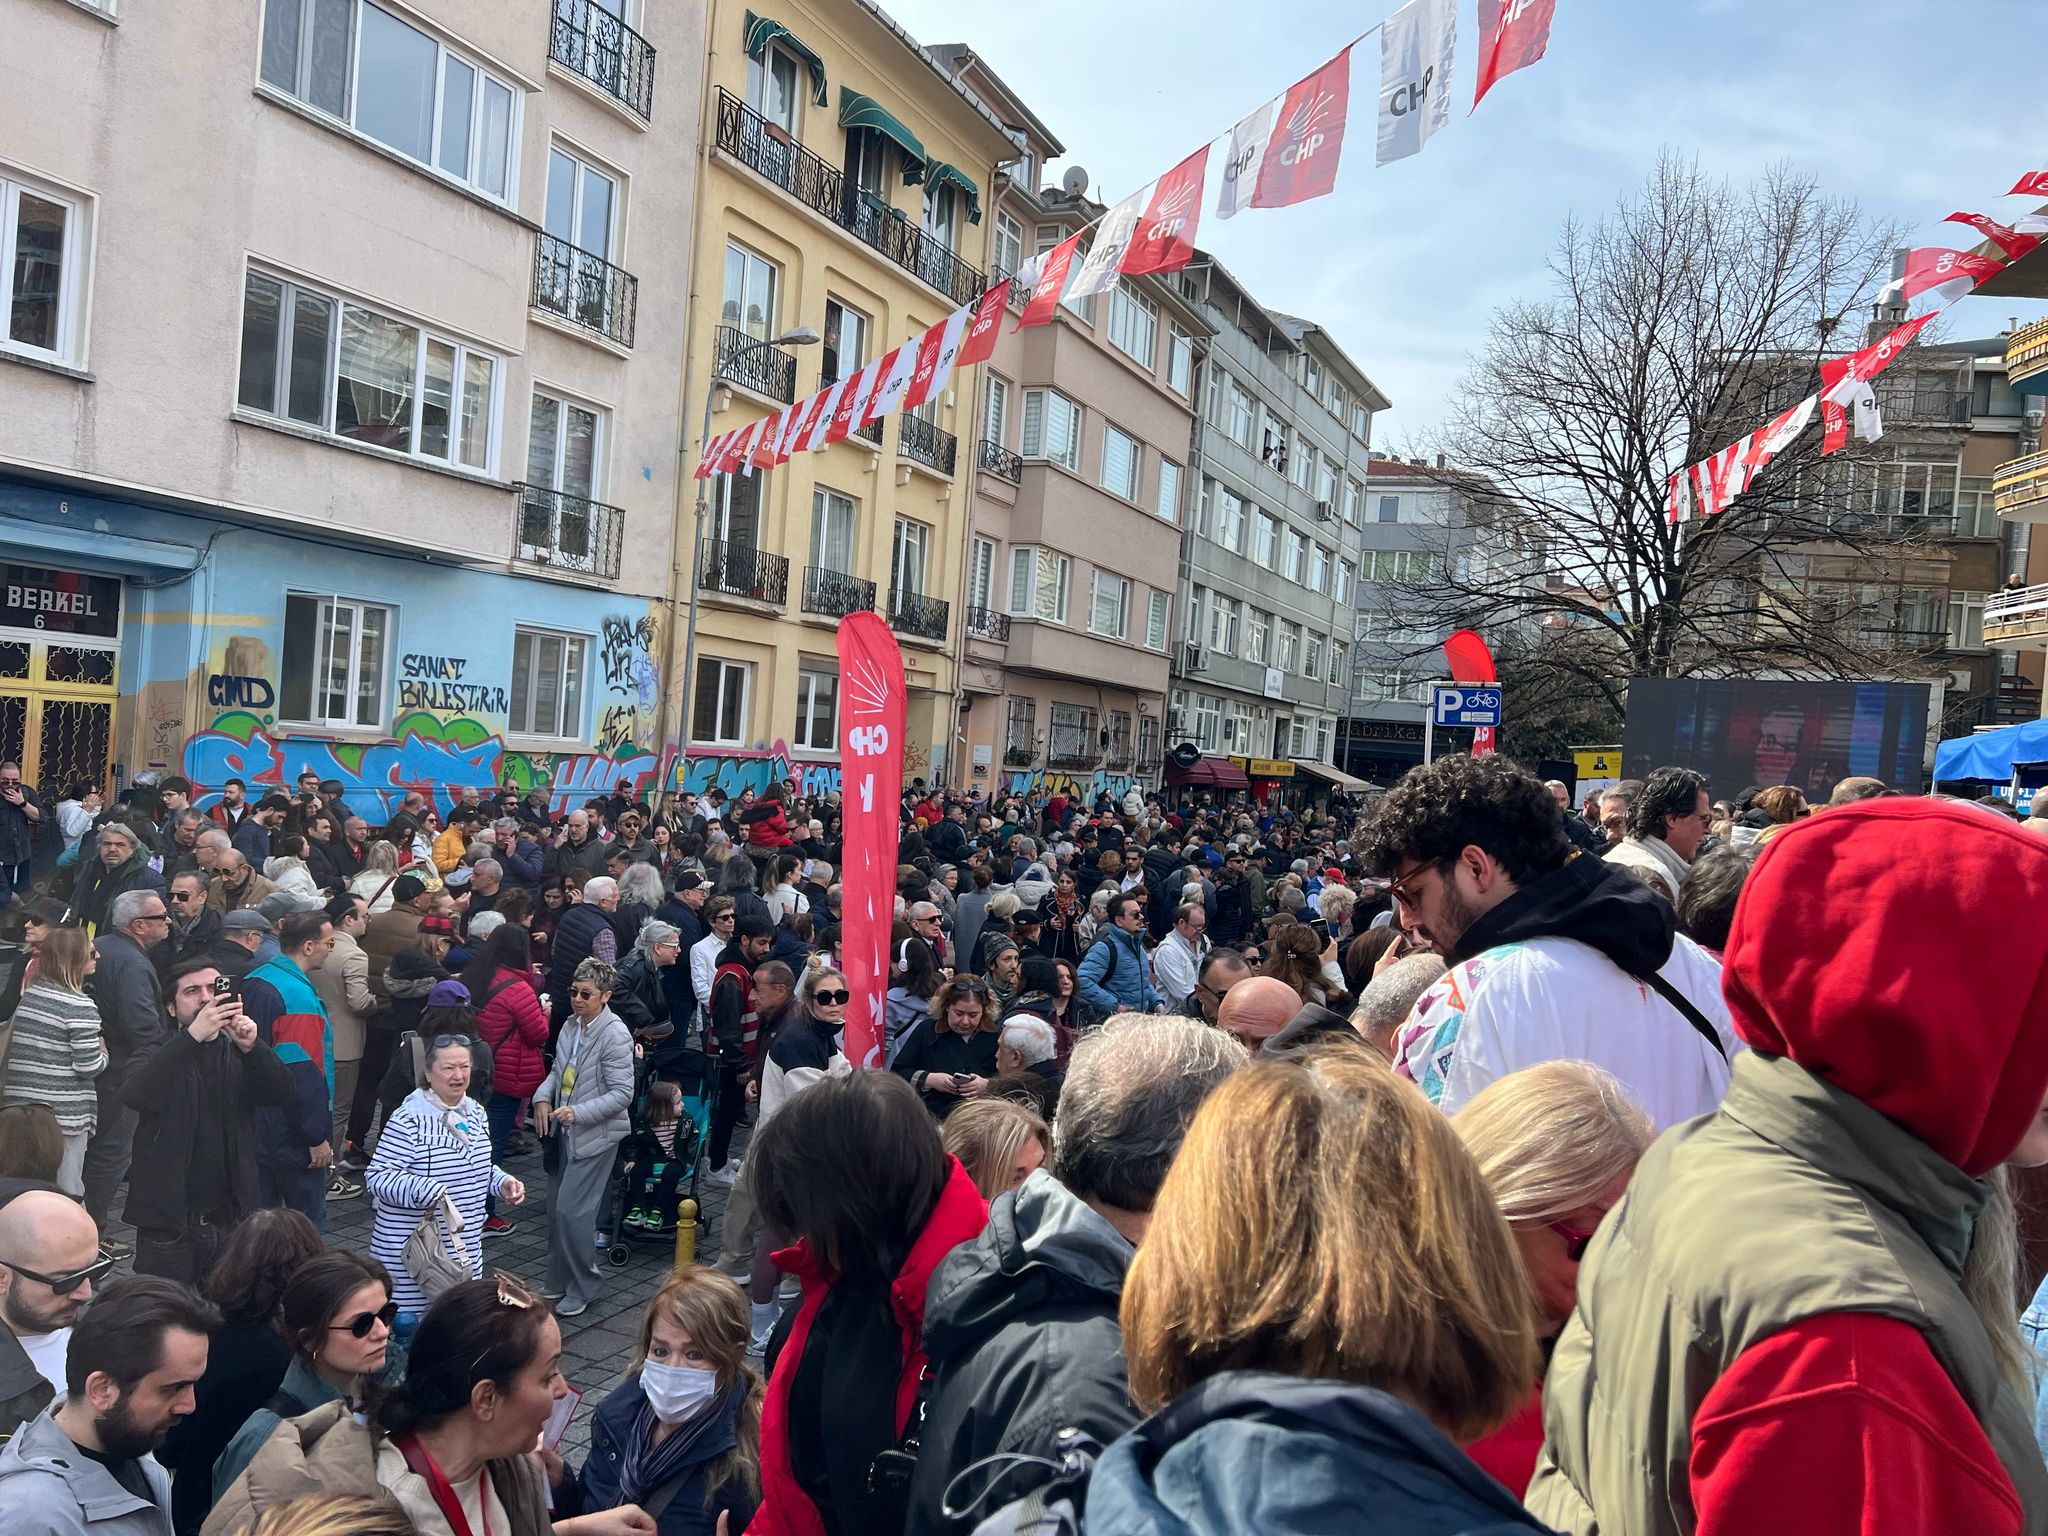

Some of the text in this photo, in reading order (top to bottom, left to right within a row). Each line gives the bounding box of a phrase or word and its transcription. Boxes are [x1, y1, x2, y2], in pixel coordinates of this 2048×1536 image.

[1389, 65, 1433, 117] CHP
[1279, 133, 1324, 166] CHP
[1224, 144, 1255, 183] CHP
[1147, 217, 1186, 242] CHP
[1935, 252, 1956, 273] CHP
[1034, 281, 1055, 298] HP
[971, 319, 992, 337] CHP
[916, 365, 932, 383] CHP
[1825, 419, 1842, 434] CHP
[762, 441, 774, 451] CH
[59, 501, 68, 514] 6
[6, 585, 99, 617] BERKEL
[34, 614, 45, 629] 6
[402, 653, 467, 680] SANAT
[1437, 690, 1463, 723] P
